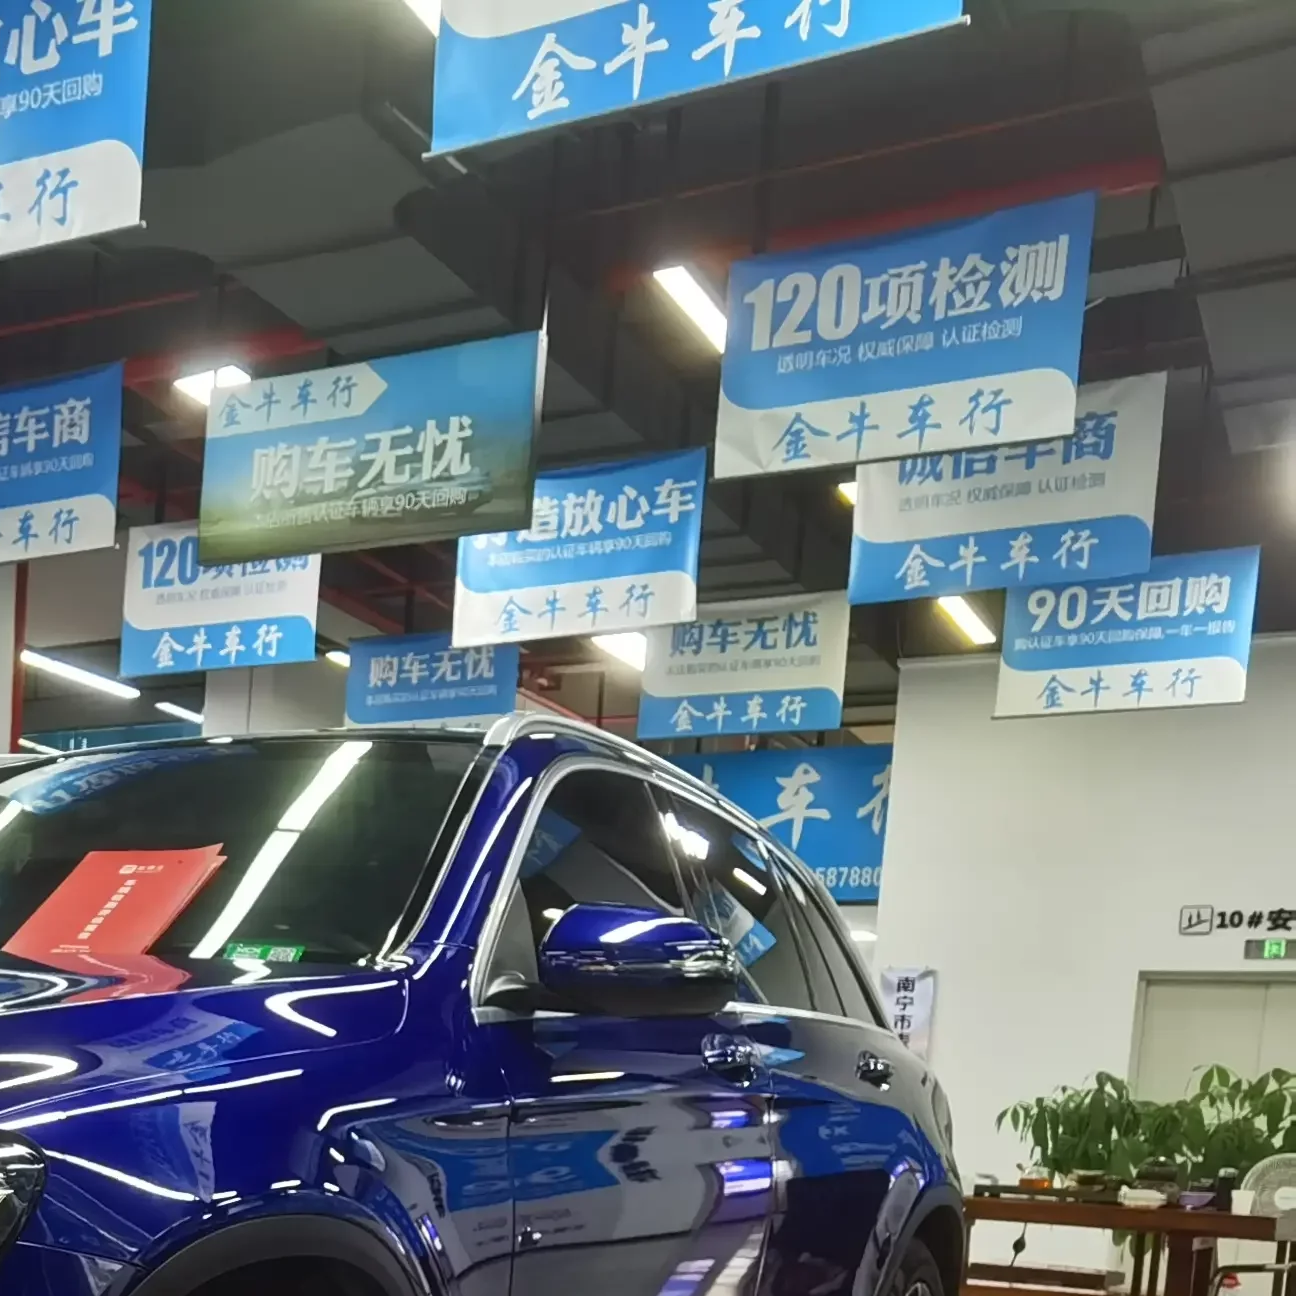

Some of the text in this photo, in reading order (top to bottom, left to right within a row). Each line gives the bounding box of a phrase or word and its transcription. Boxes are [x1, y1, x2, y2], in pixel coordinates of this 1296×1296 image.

[743, 234, 1070, 352] 120项检测
[941, 315, 1023, 348] 认证检测
[219, 374, 359, 429] 金牛车行
[771, 387, 1014, 464] 金牛车行
[249, 415, 474, 503] 购车无忧
[895, 528, 1100, 592] 金牛车行
[496, 583, 655, 635] 金牛车行
[1027, 573, 1231, 634] 90天回购
[152, 623, 284, 669] 金牛车行
[669, 610, 819, 659] 购车无忧
[368, 645, 495, 689] 购车无忧
[1037, 667, 1202, 709] 金牛车行
[669, 695, 808, 733] 金牛车行
